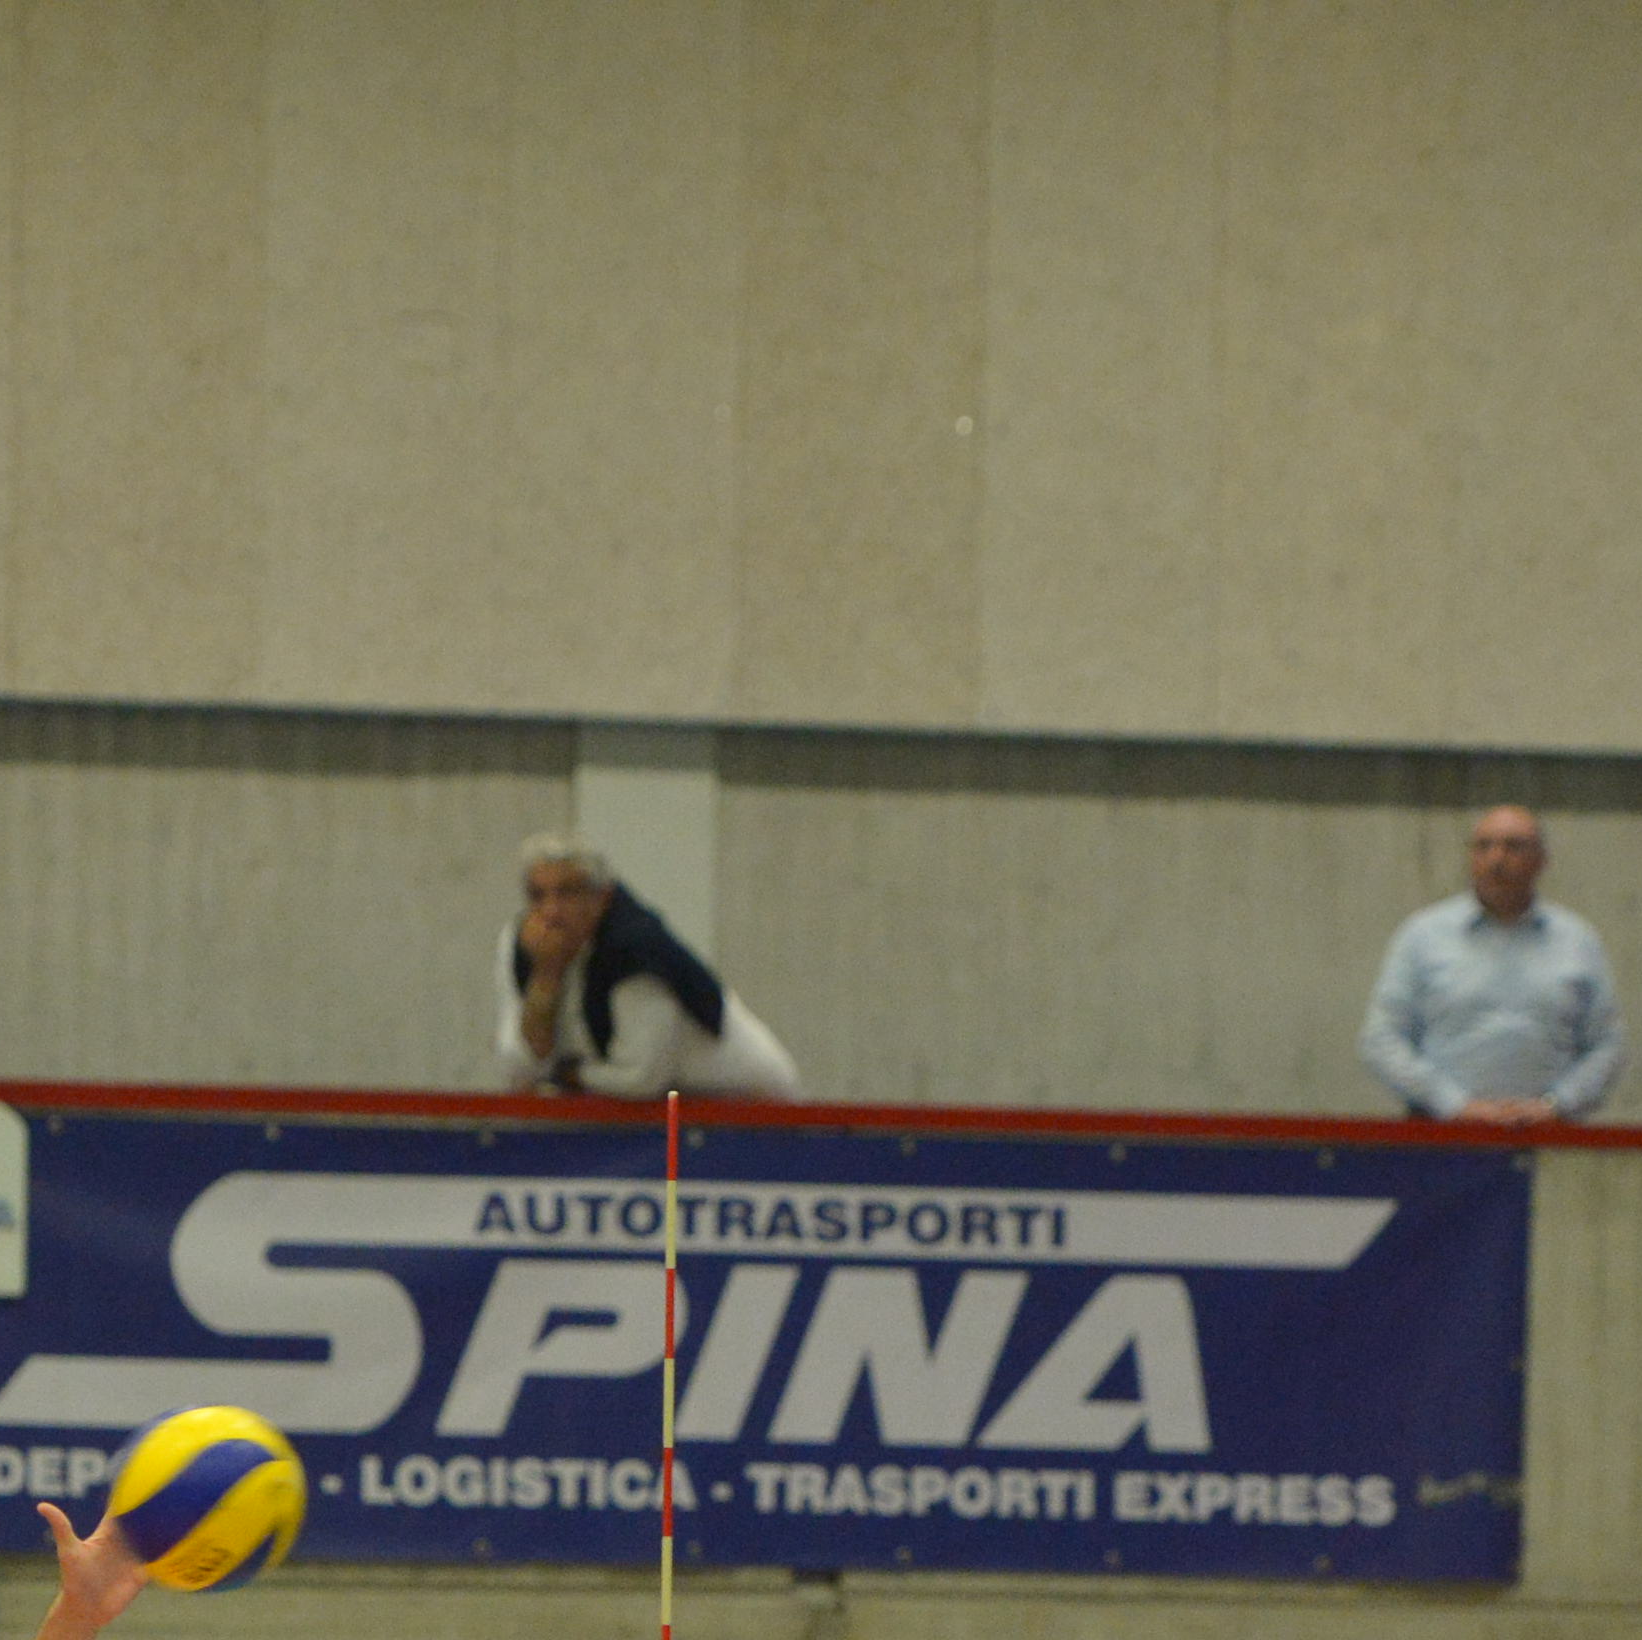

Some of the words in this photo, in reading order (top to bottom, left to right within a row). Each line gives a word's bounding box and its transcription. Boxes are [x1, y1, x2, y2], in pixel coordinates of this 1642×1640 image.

[473, 1191, 1068, 1248] AUTOTRASPORTI
[361, 1458, 697, 1510] LOGISTICA
[748, 1463, 1096, 1520] TRASPORTI
[1113, 1471, 1398, 1527] EXPRESS
